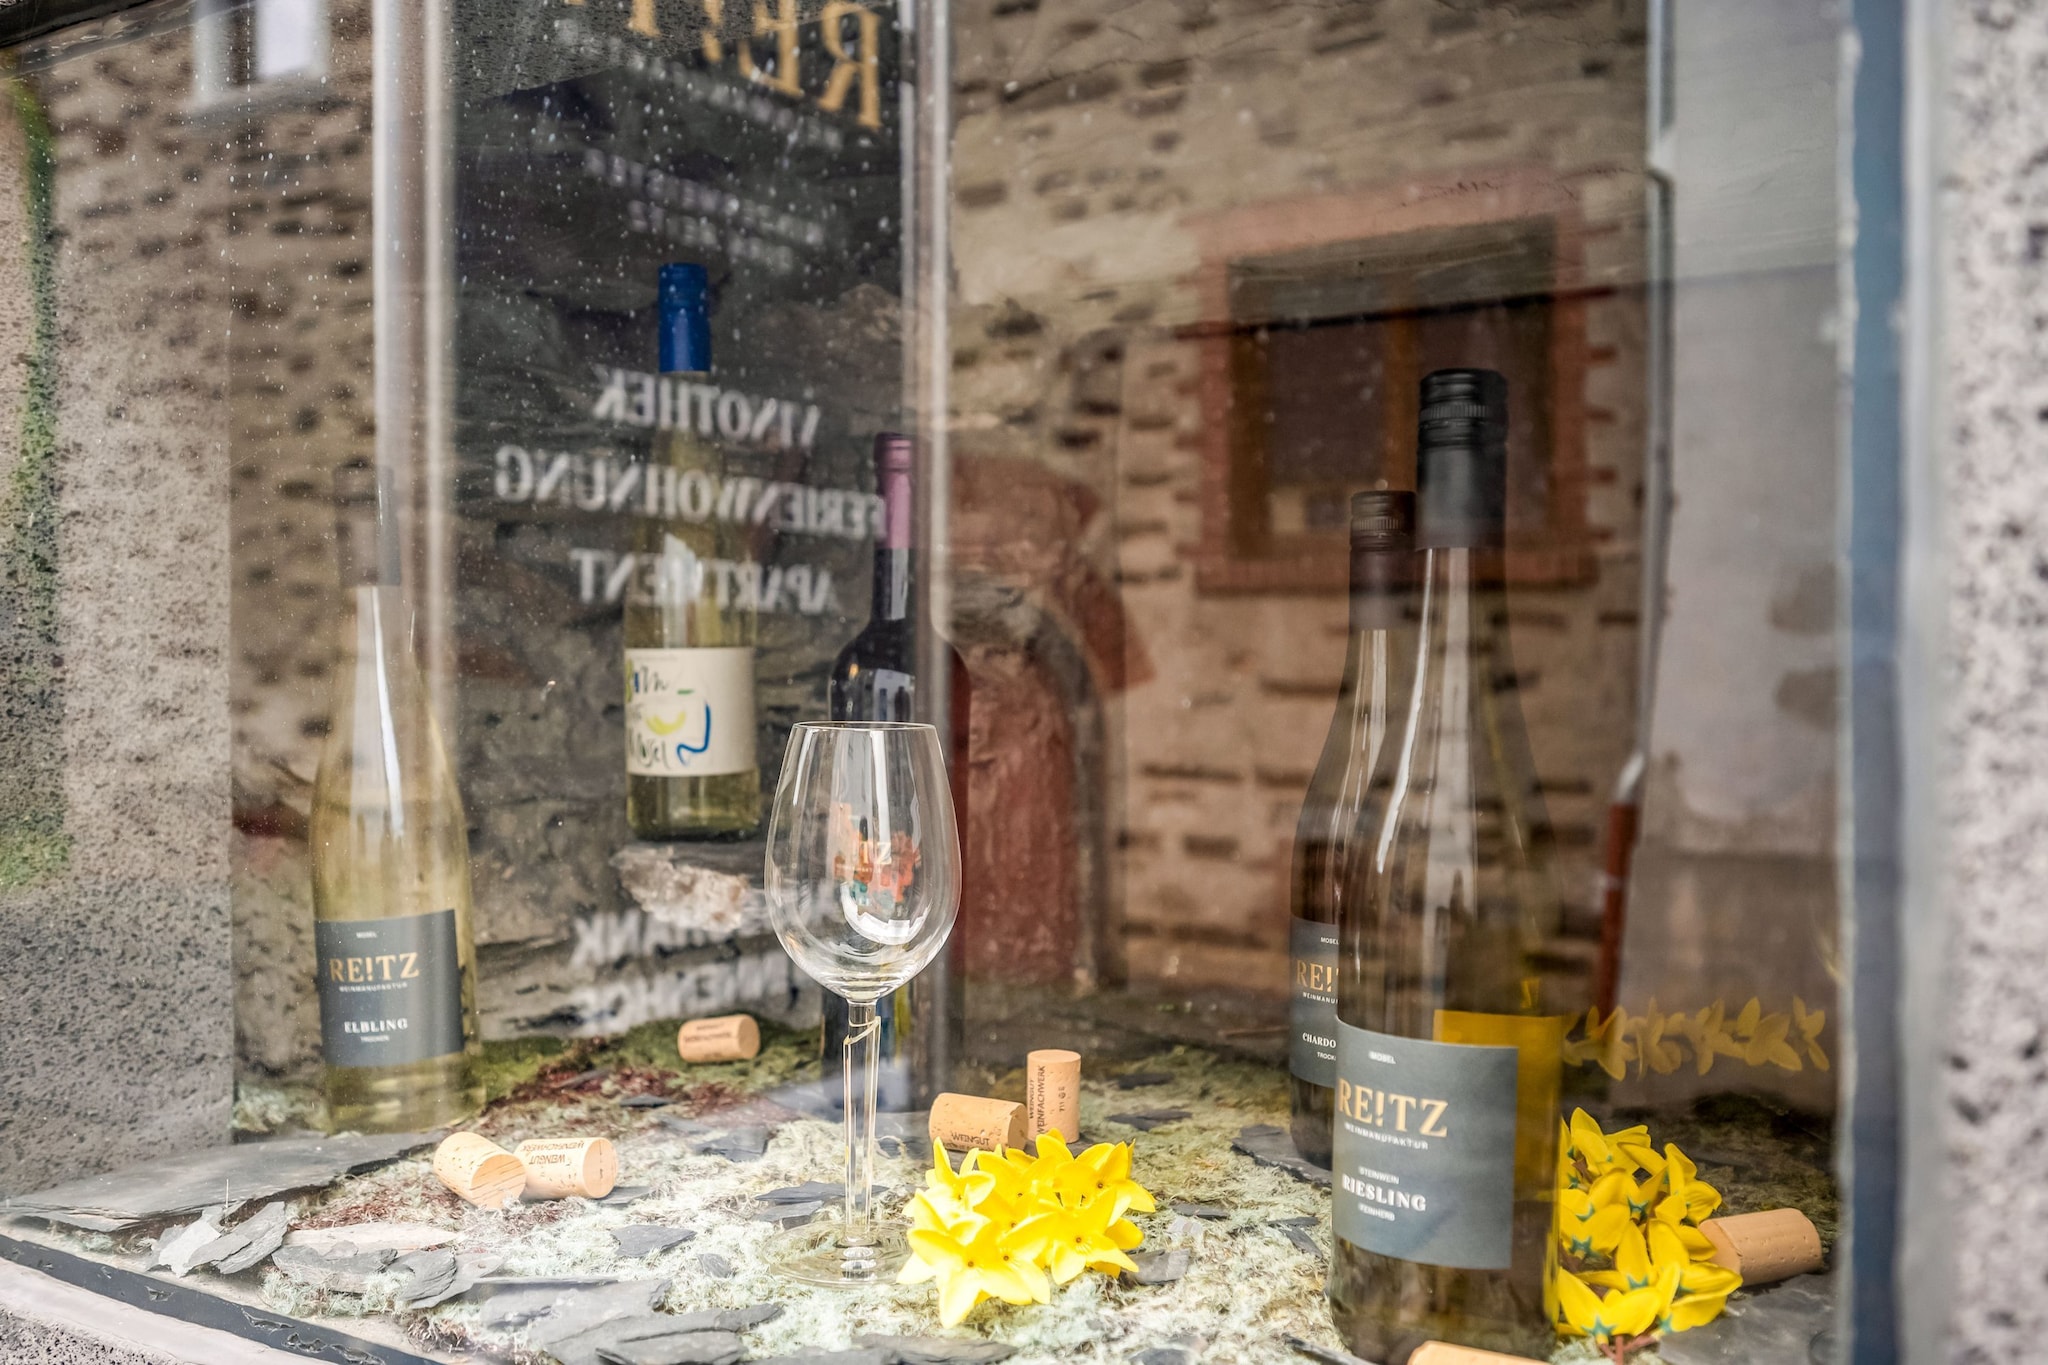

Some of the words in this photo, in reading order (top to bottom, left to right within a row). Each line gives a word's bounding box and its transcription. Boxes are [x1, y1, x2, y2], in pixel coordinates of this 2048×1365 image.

[1296, 959, 1339, 993] RE!
[344, 1018, 409, 1034] ELBLING
[1337, 1078, 1449, 1139] RE!TZ
[951, 1131, 990, 1146] WEINGUT
[1344, 1122, 1429, 1151] WEINMANUFAKTUR
[529, 1153, 566, 1166] WEINGUT
[1342, 1173, 1427, 1212] RIESLING
